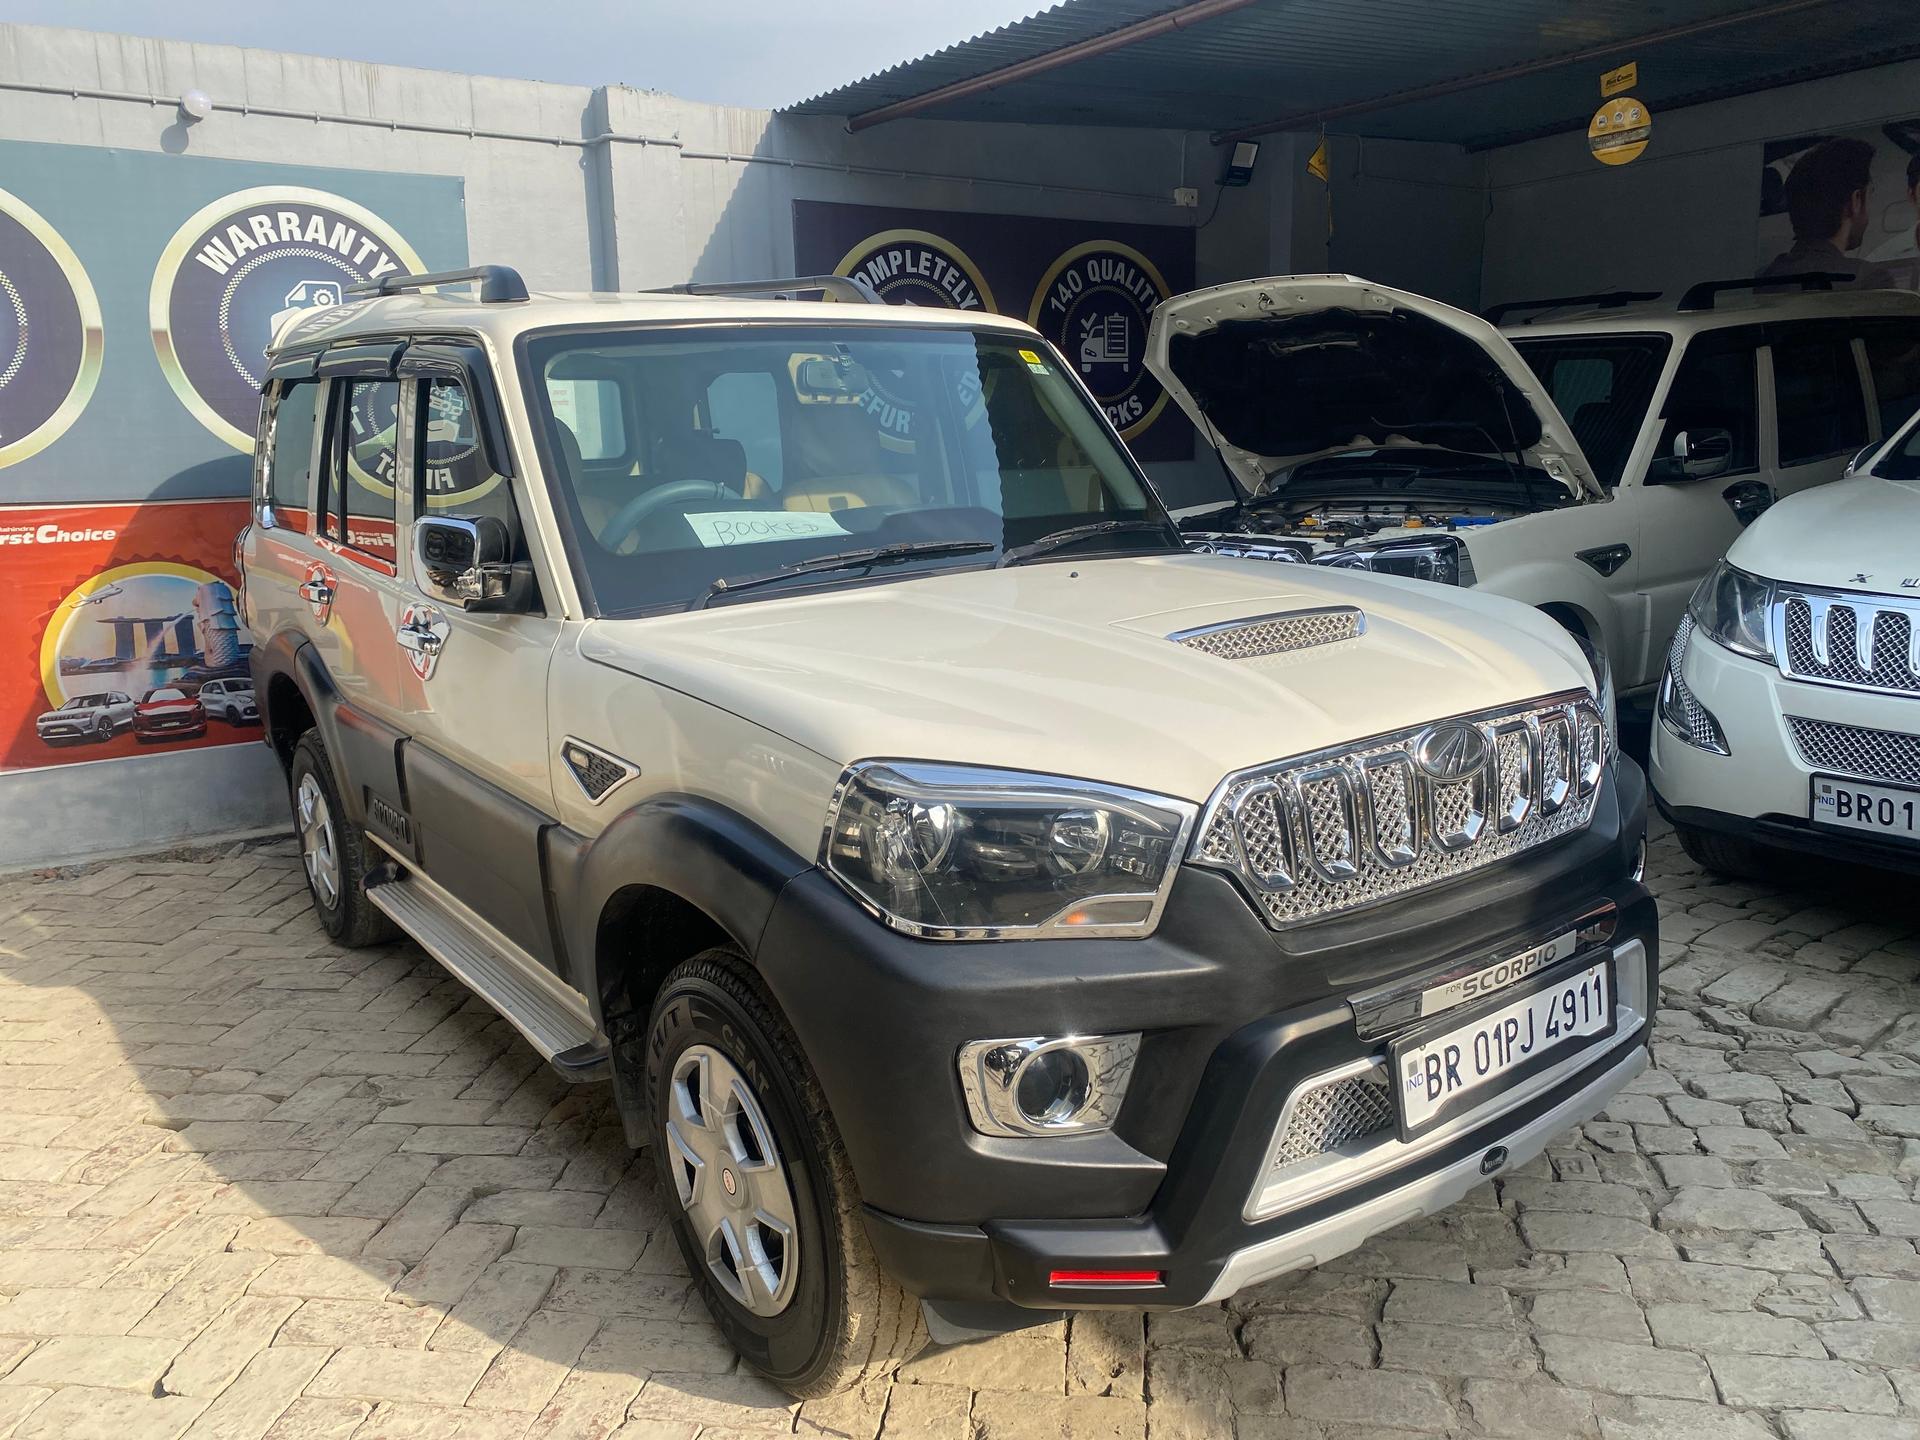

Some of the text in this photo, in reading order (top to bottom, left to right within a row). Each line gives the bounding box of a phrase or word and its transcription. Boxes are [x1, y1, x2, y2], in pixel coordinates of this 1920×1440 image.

[195, 211, 398, 279] WARRANTY
[854, 249, 979, 310] OMPLETELY
[1050, 269, 1083, 312] 140
[1102, 395, 1143, 427] CKS
[0, 524, 116, 545] rst Choice
[712, 520, 819, 546] BOOKED
[1836, 789, 1914, 831] BR01
[1446, 943, 1557, 998] FOR SCORPIO
[1425, 974, 1603, 1102] BR 01PJ 4911
[1406, 1073, 1424, 1093] IND
